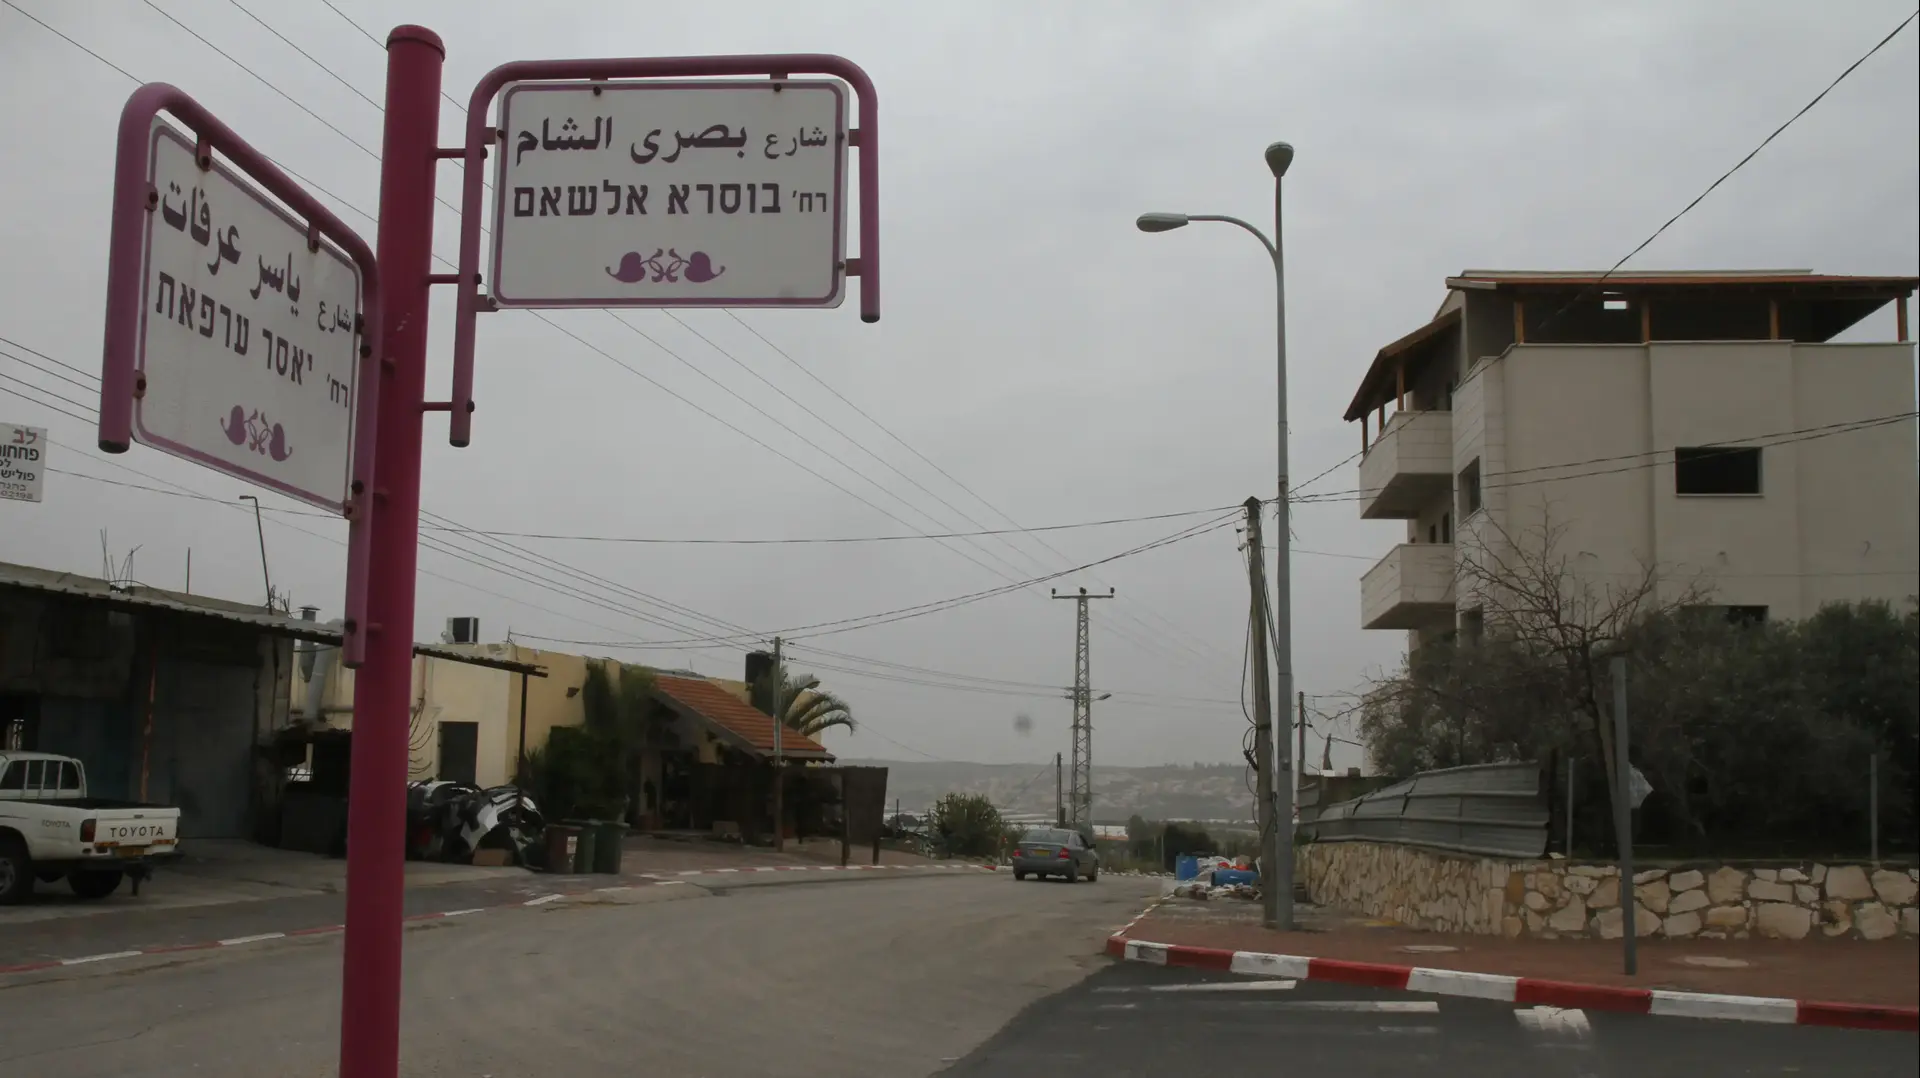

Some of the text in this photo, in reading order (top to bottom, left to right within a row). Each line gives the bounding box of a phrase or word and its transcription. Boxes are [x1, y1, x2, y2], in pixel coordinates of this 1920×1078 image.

[515, 115, 828, 167] شارع بصرى الشام
[513, 179, 827, 218] רח' בוסרא אלשאם
[162, 180, 352, 335] شارع ياسر عرفات
[155, 270, 349, 411] רח' יאסר ערפאת
[0, 444, 40, 462] פחחו
[1, 468, 36, 482] פוליש
[41, 819, 71, 829] TOYOTA
[110, 826, 164, 838] TOYOTA
